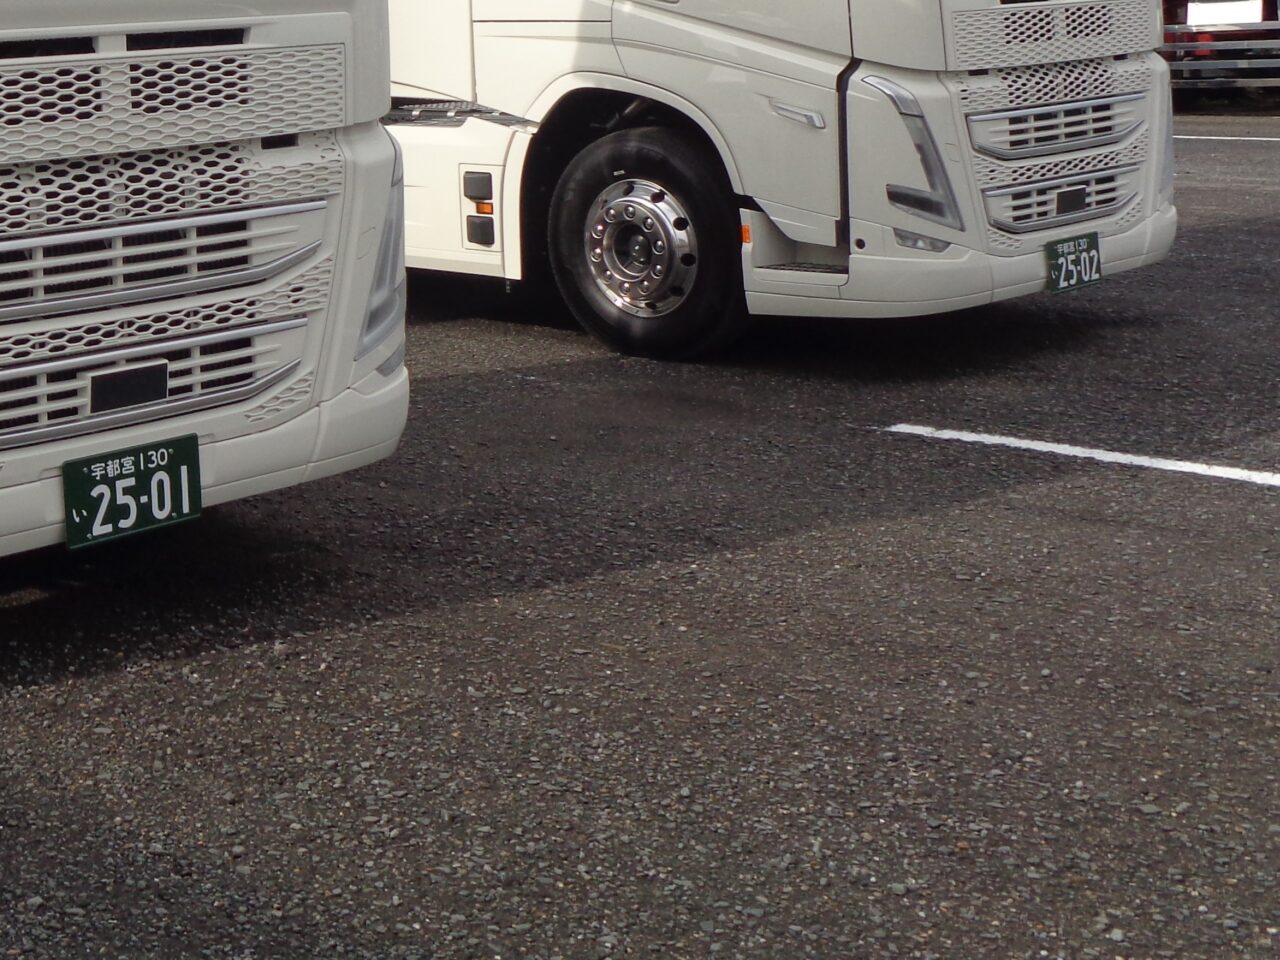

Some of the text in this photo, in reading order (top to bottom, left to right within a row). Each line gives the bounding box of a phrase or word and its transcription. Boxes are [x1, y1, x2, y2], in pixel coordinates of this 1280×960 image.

[1057, 249, 1100, 288] 25-02
[90, 448, 168, 480] 宇都宮 130
[72, 465, 190, 537] い 25-01
